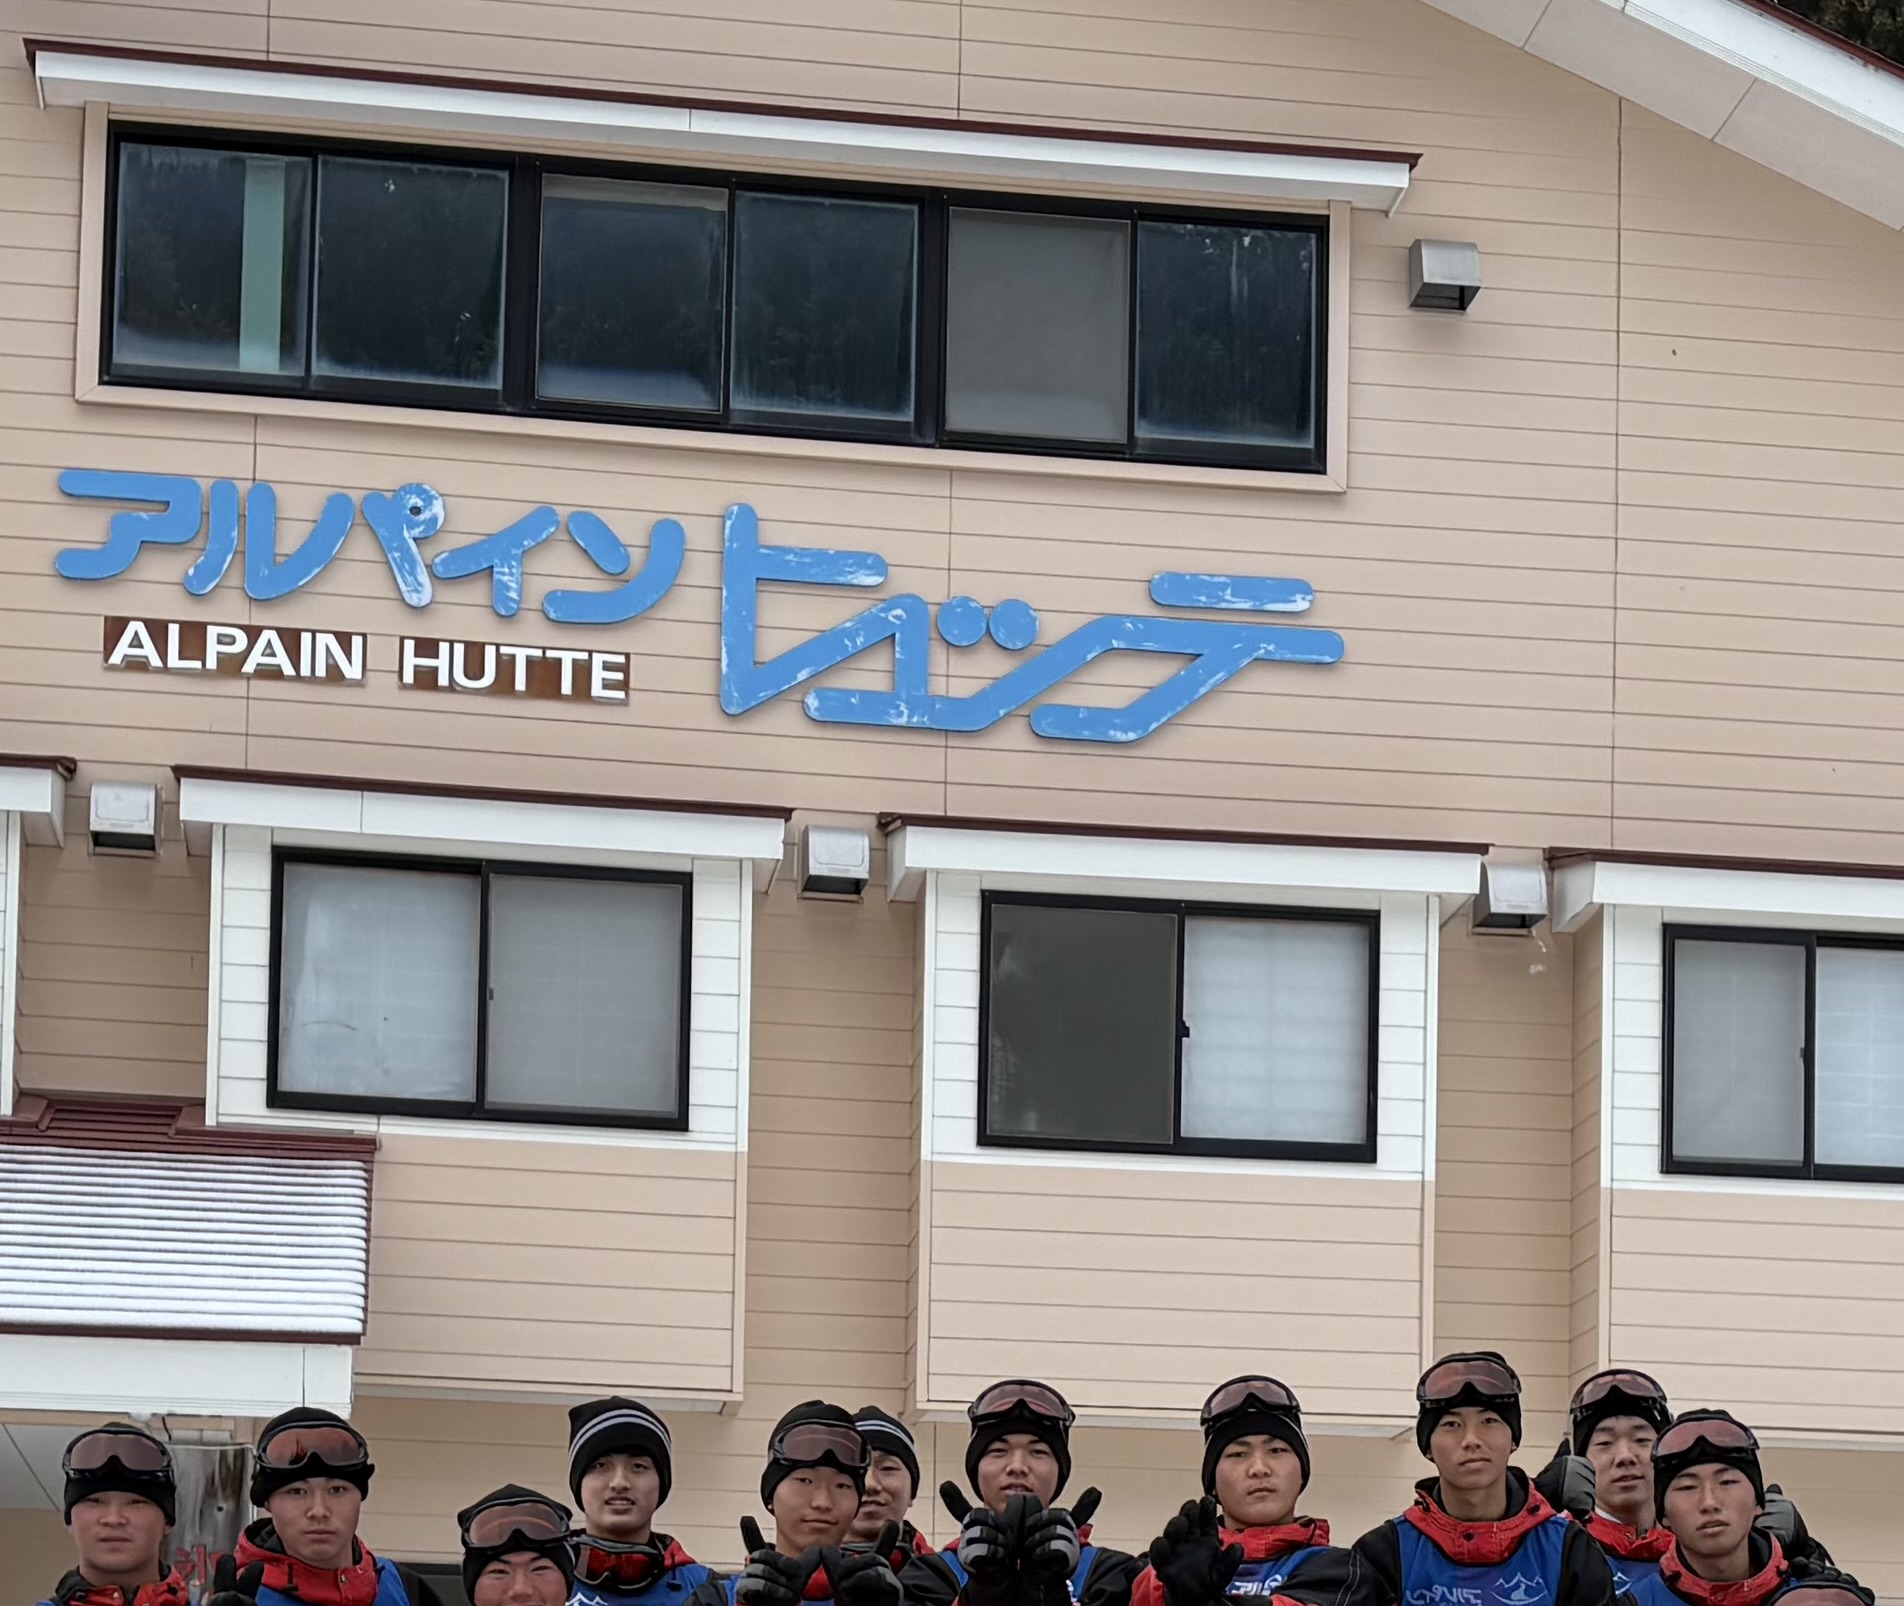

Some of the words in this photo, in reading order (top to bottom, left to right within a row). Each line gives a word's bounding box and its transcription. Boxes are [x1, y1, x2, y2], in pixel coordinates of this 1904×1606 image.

[56, 468, 686, 624] アルパイン
[721, 502, 1343, 743] ヒュッテ
[107, 620, 365, 681] ALPAIN
[402, 638, 627, 701] HUTTE
